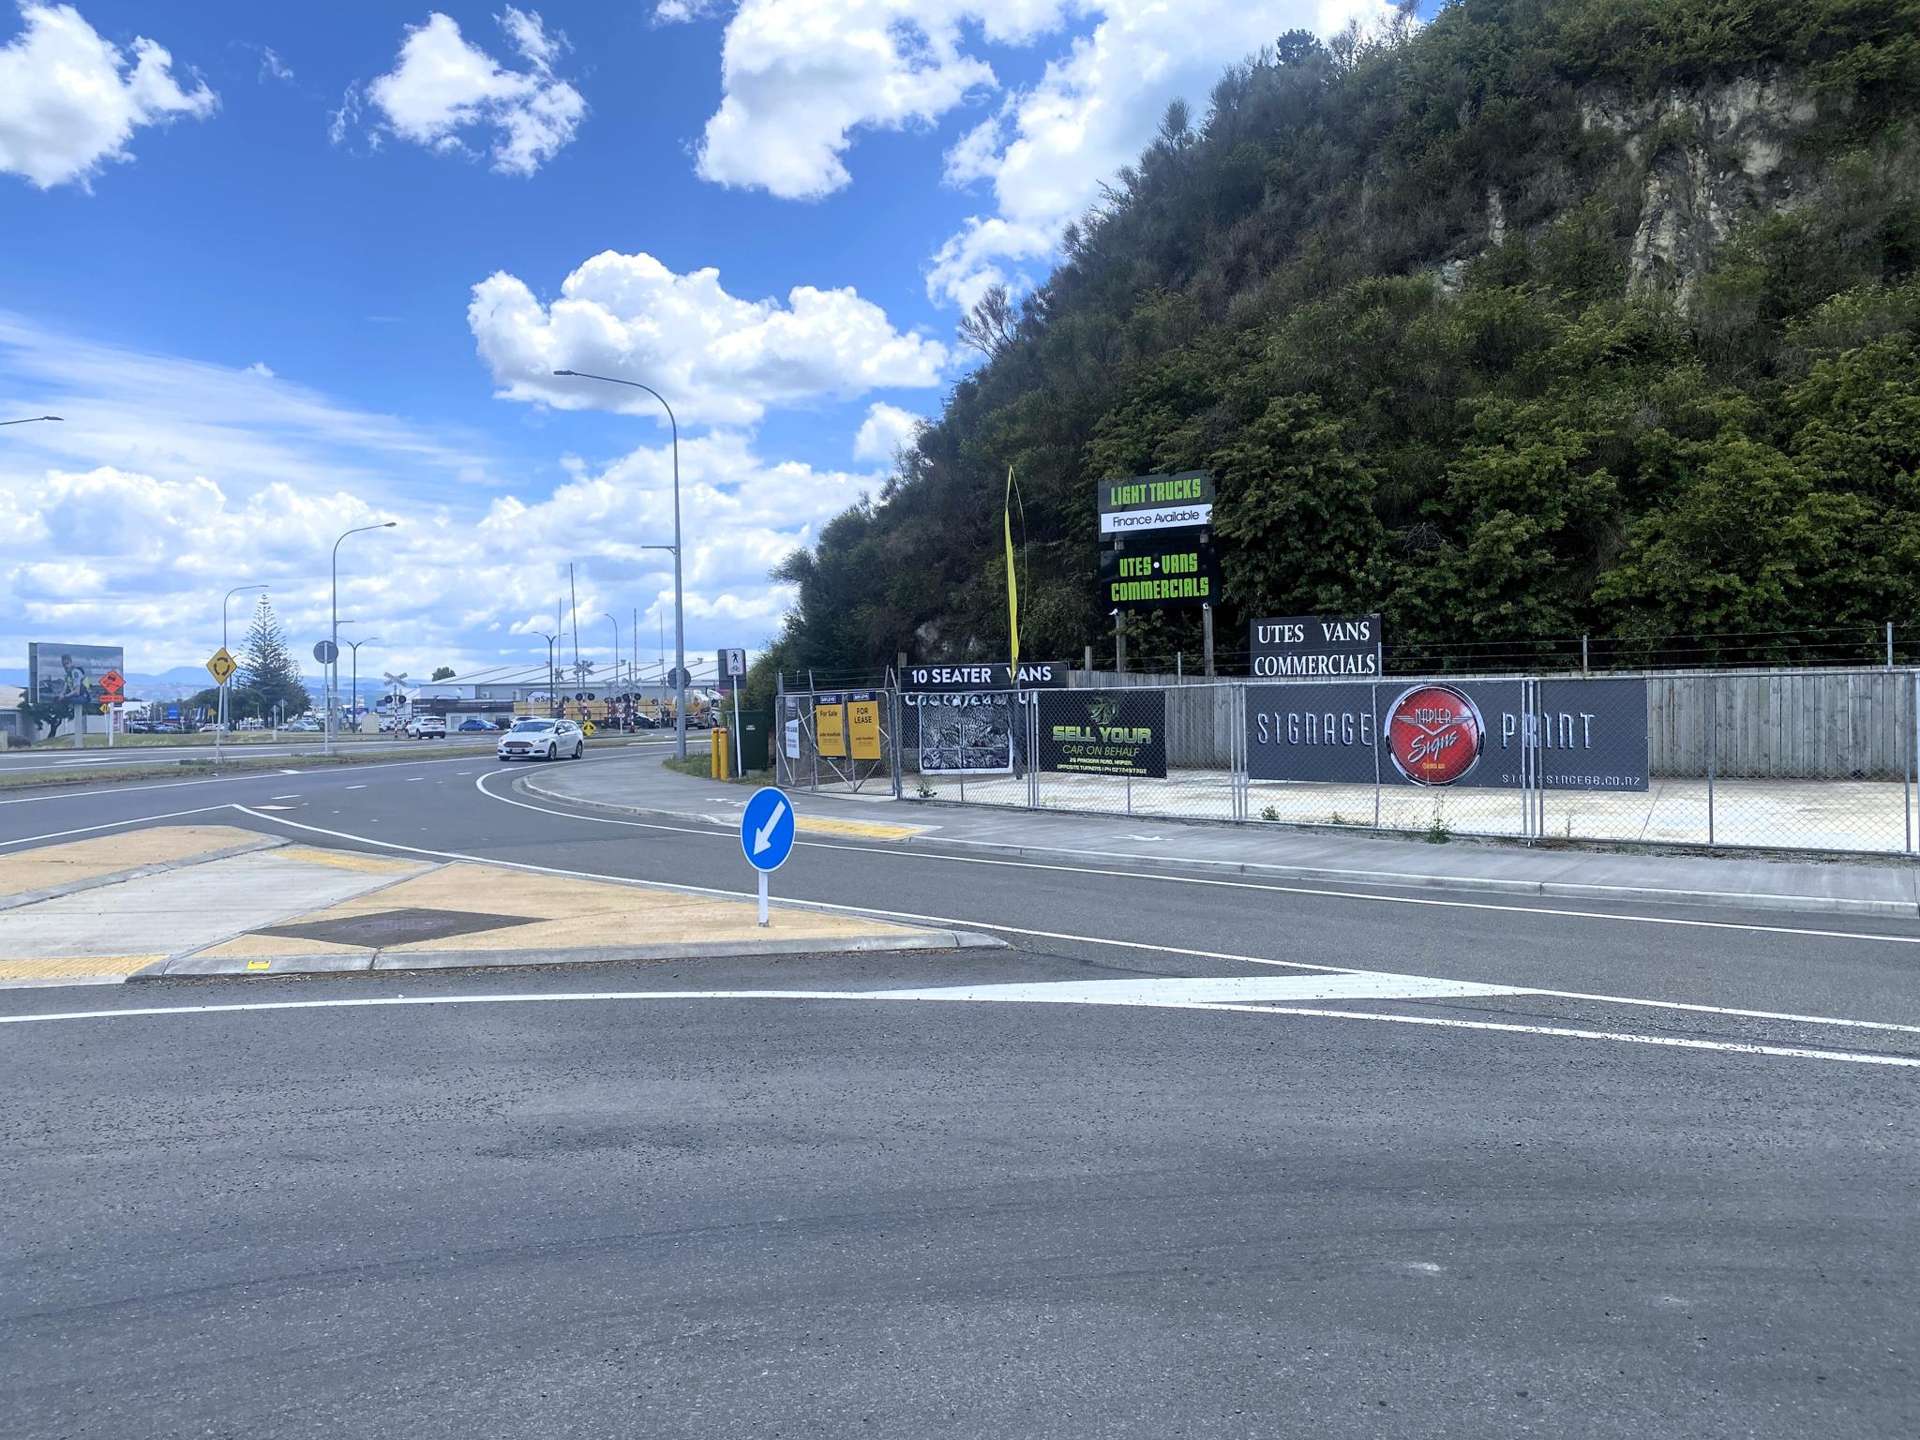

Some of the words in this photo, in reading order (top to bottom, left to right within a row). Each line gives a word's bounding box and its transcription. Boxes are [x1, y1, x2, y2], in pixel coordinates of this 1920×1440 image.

[1110, 484, 1147, 506] LIGHT
[1149, 478, 1201, 502] TRUCKS
[1112, 515, 1152, 528] Finance
[1154, 510, 1200, 524] Available
[1119, 556, 1152, 577] UTES
[1161, 552, 1198, 574] VANS
[1110, 576, 1209, 602] COMMERCIALS
[1257, 623, 1305, 644] UTES
[1321, 621, 1370, 641] VANS
[1254, 653, 1376, 676] COMMERCIALS
[911, 669, 928, 684] 10
[931, 667, 992, 684] SEATER
[854, 716, 872, 724] LEASE
[856, 707, 869, 715] FOR
[1415, 708, 1452, 724] NAPIER
[1053, 725, 1097, 742] SELL
[1099, 727, 1152, 744] YOUR
[1257, 711, 1374, 746] SIGNAGE
[1062, 744, 1084, 754] CAR
[1086, 745, 1102, 755] ON
[1104, 747, 1140, 757] BEHALF
[1407, 730, 1459, 763] Signs
